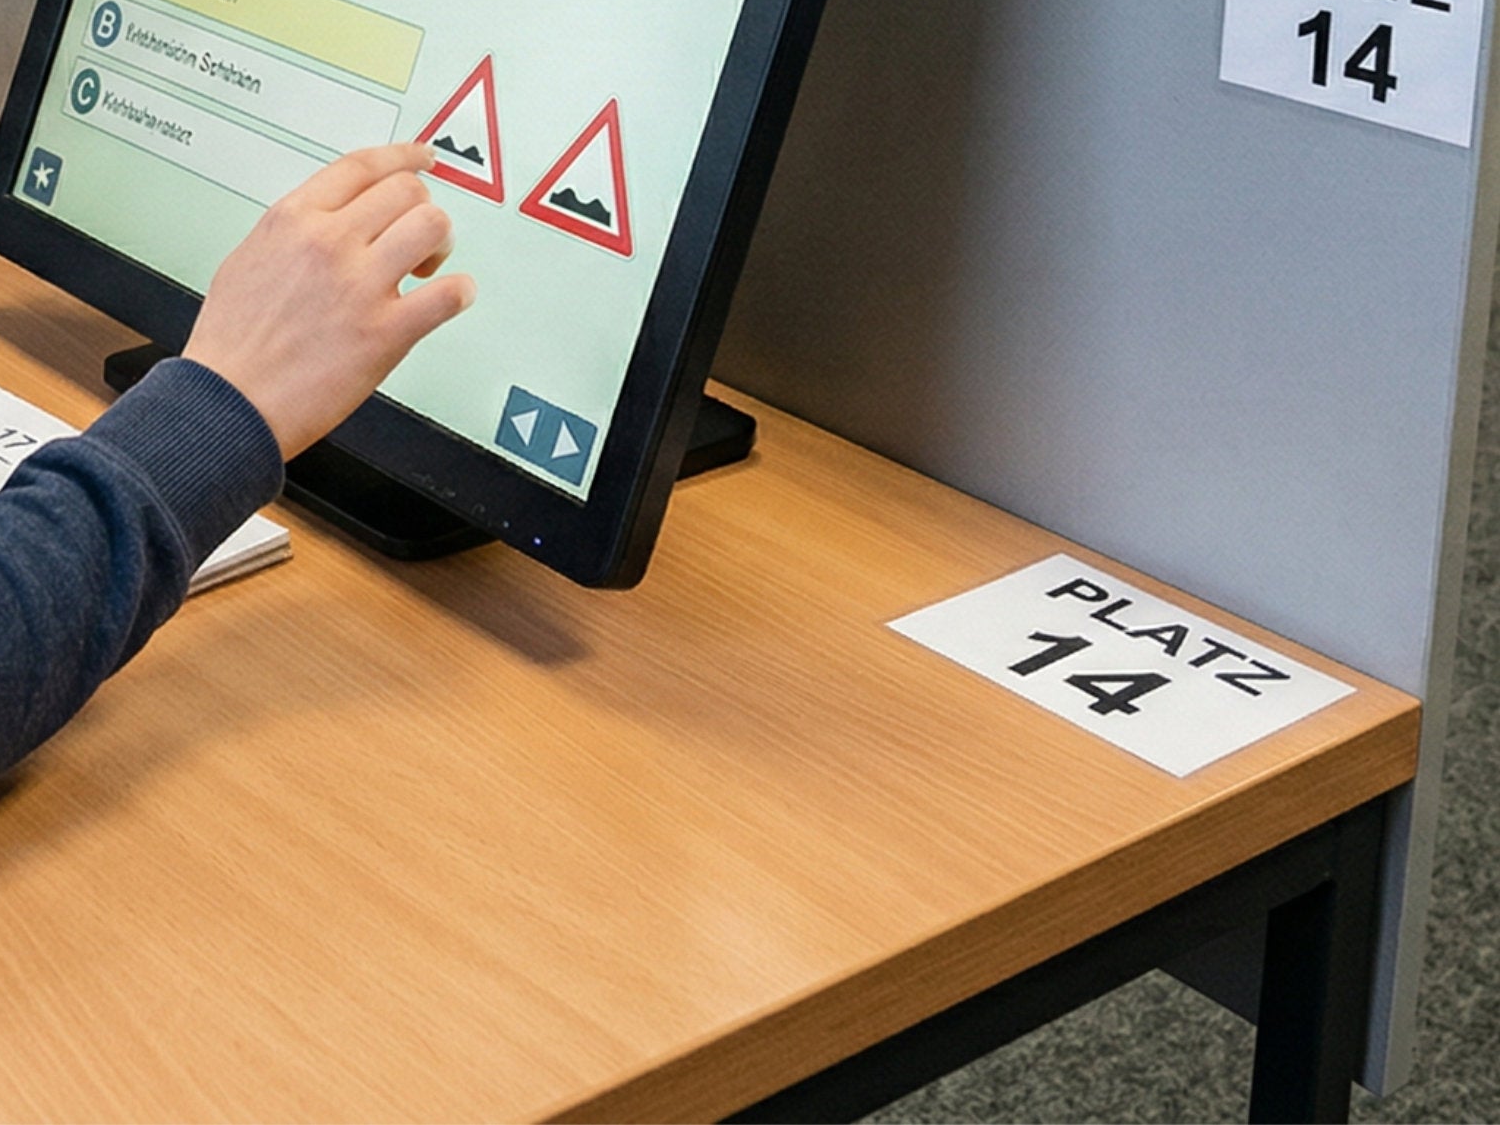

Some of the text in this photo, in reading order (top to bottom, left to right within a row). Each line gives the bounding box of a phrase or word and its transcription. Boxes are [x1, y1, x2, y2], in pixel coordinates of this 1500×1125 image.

[96, 9, 116, 38] B
[1297, 9, 1398, 104] 14
[77, 77, 95, 106] C
[1007, 631, 1172, 716] 14
[1044, 578, 1291, 697] PLATZ
